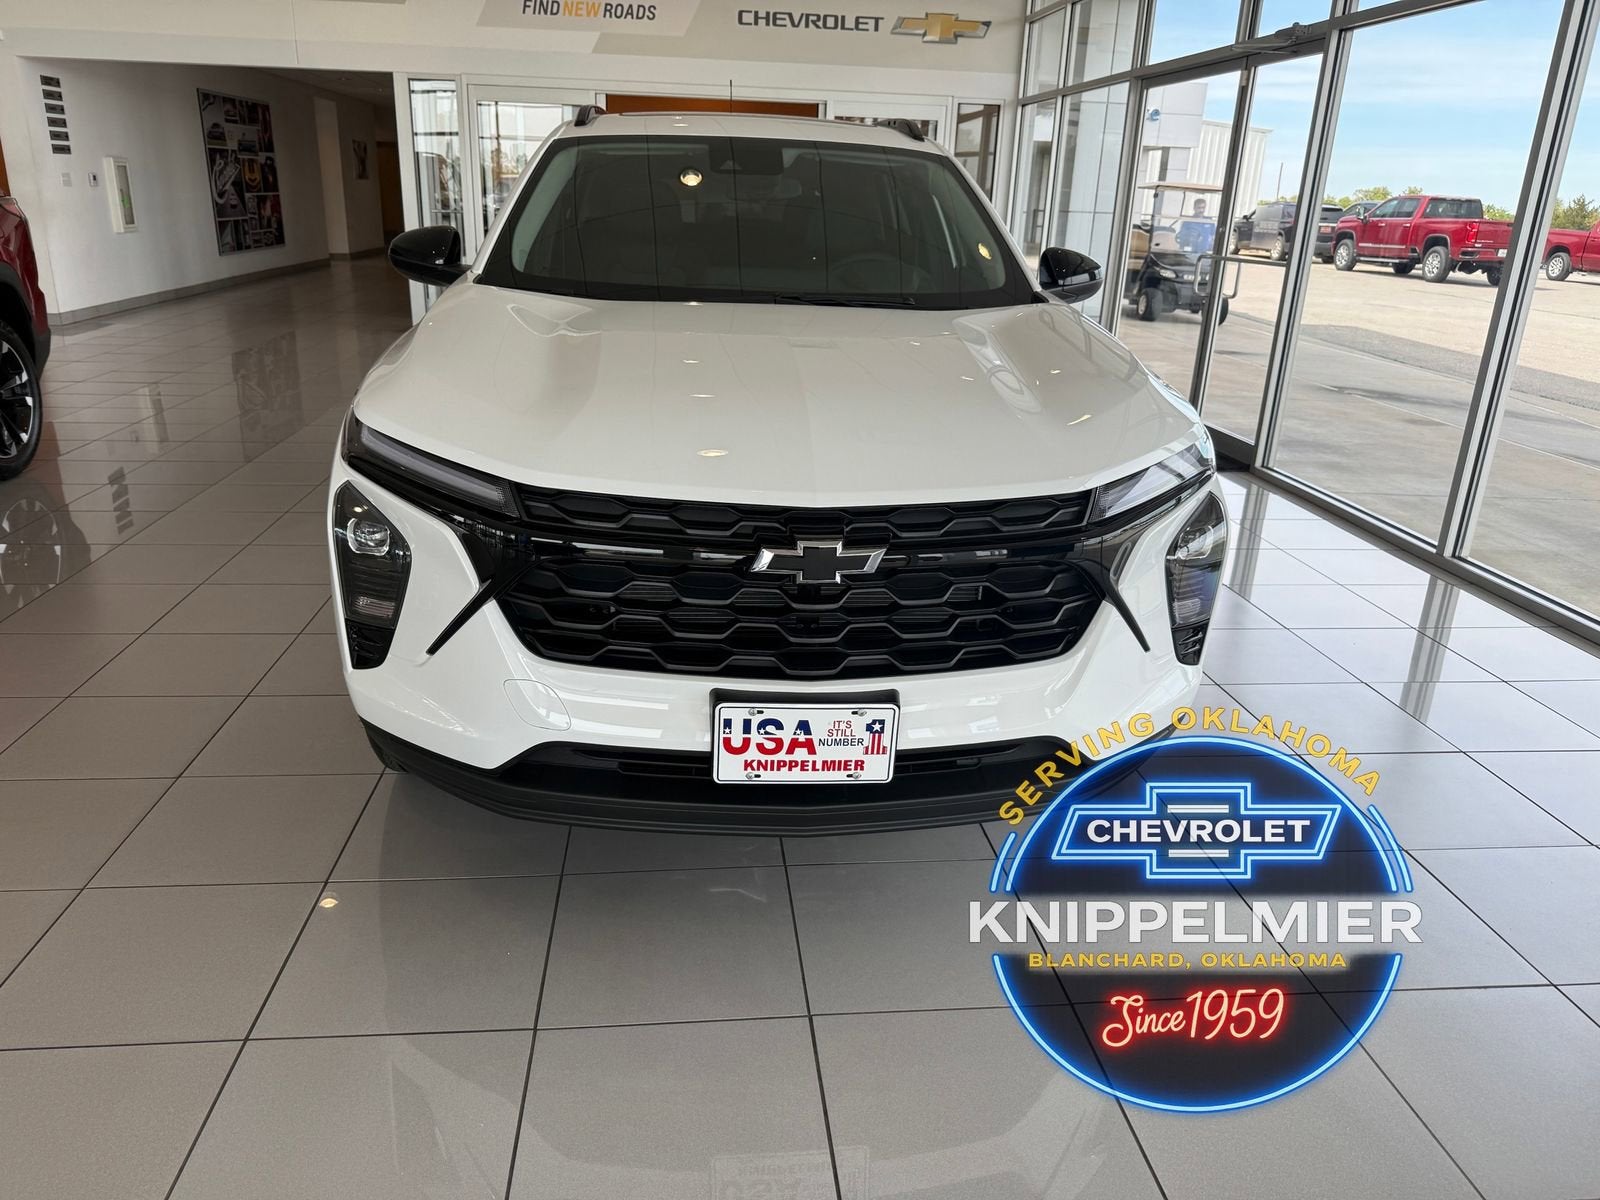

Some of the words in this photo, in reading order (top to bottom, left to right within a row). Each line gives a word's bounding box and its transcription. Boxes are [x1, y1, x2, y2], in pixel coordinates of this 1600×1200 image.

[522, 0, 560, 16] FIND
[562, 0, 600, 17] NEW
[603, 3, 656, 20] ROADS
[737, 9, 884, 33] CHEVROLET
[832, 720, 852, 729] IT'S
[722, 718, 817, 755] USA
[827, 728, 856, 737] STILL
[818, 737, 864, 747] NUMBER
[743, 759, 865, 772] KNIPPELMIER
